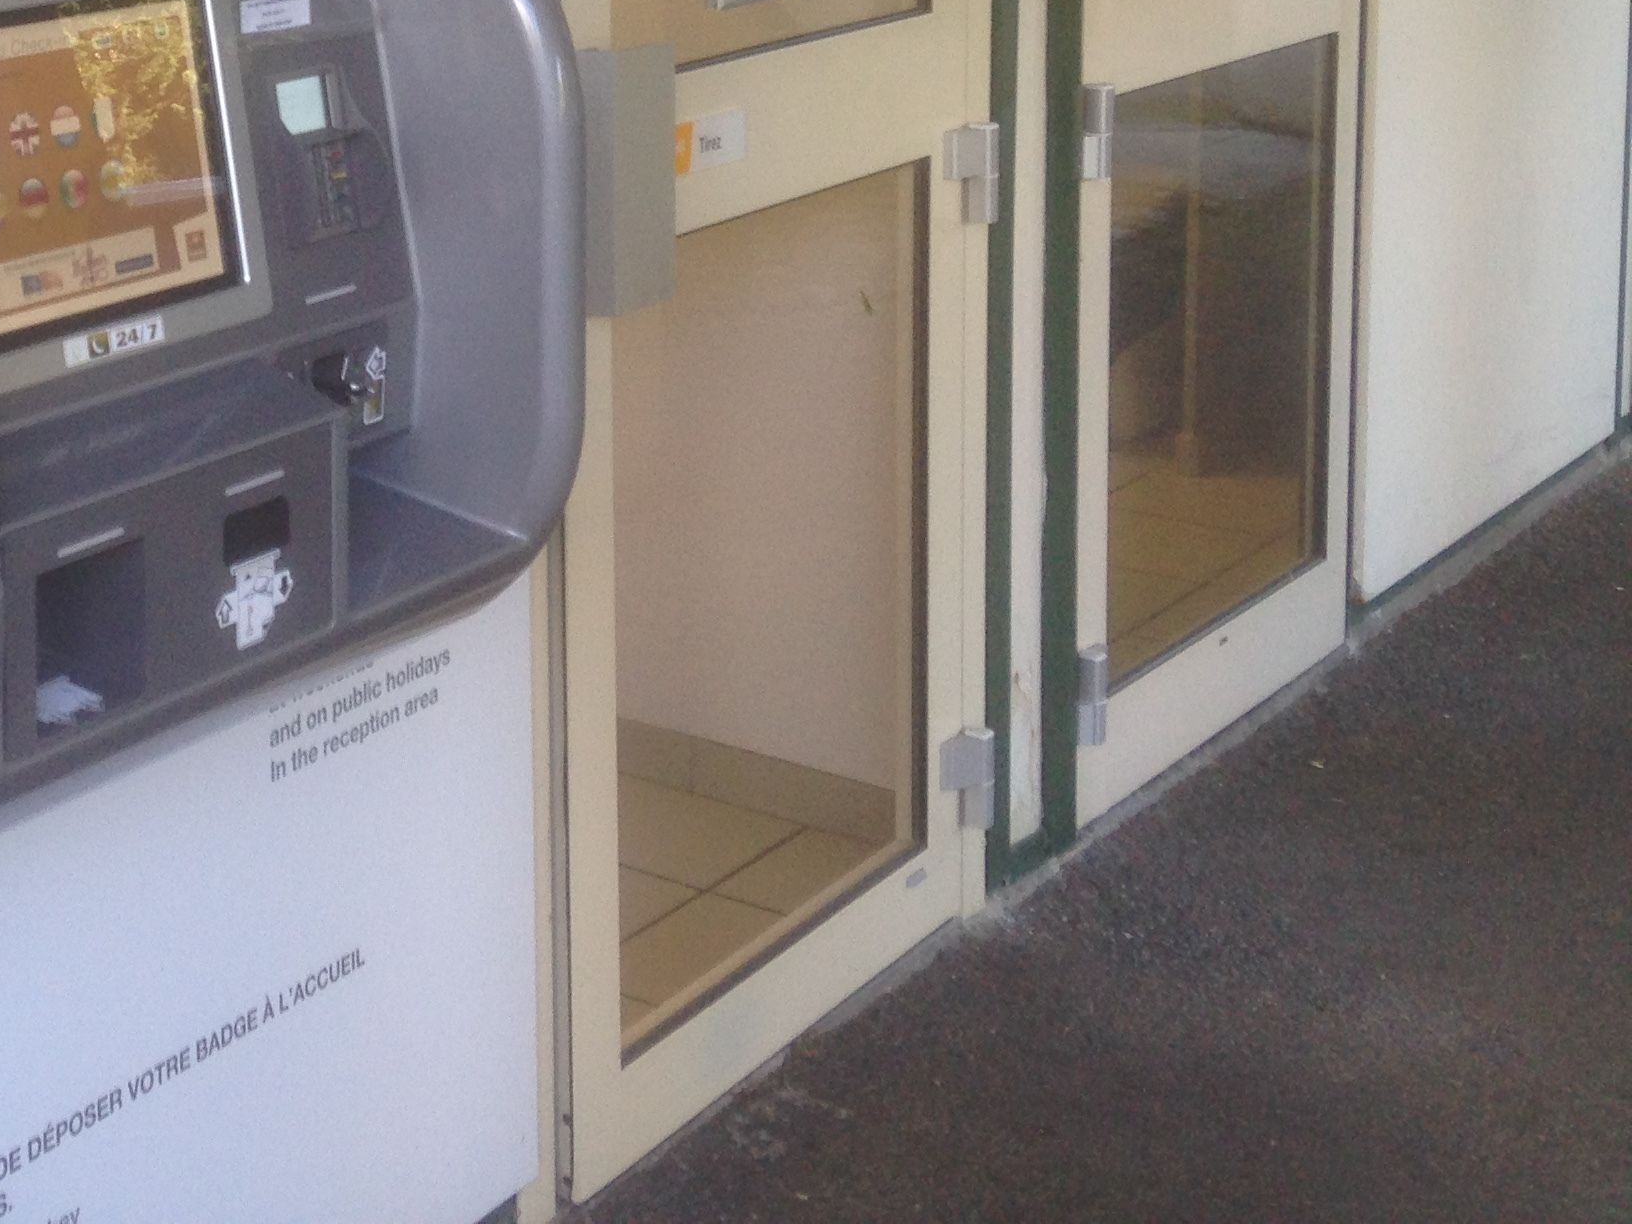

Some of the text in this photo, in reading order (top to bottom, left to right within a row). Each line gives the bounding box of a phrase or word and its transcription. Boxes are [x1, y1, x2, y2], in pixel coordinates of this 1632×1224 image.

[269, 714, 301, 748] and
[307, 707, 327, 730] on
[332, 680, 382, 722] public
[386, 649, 450, 692] holidays
[291, 746, 318, 772] the
[323, 705, 400, 756] reception
[404, 688, 438, 717] area
[27, 1087, 123, 1162] DÉPOSER
[127, 1046, 191, 1102] VOTRE
[196, 1007, 258, 1064] BADGE
[262, 993, 275, 1025] À
[279, 947, 365, 1015] L'ACCUEIL
